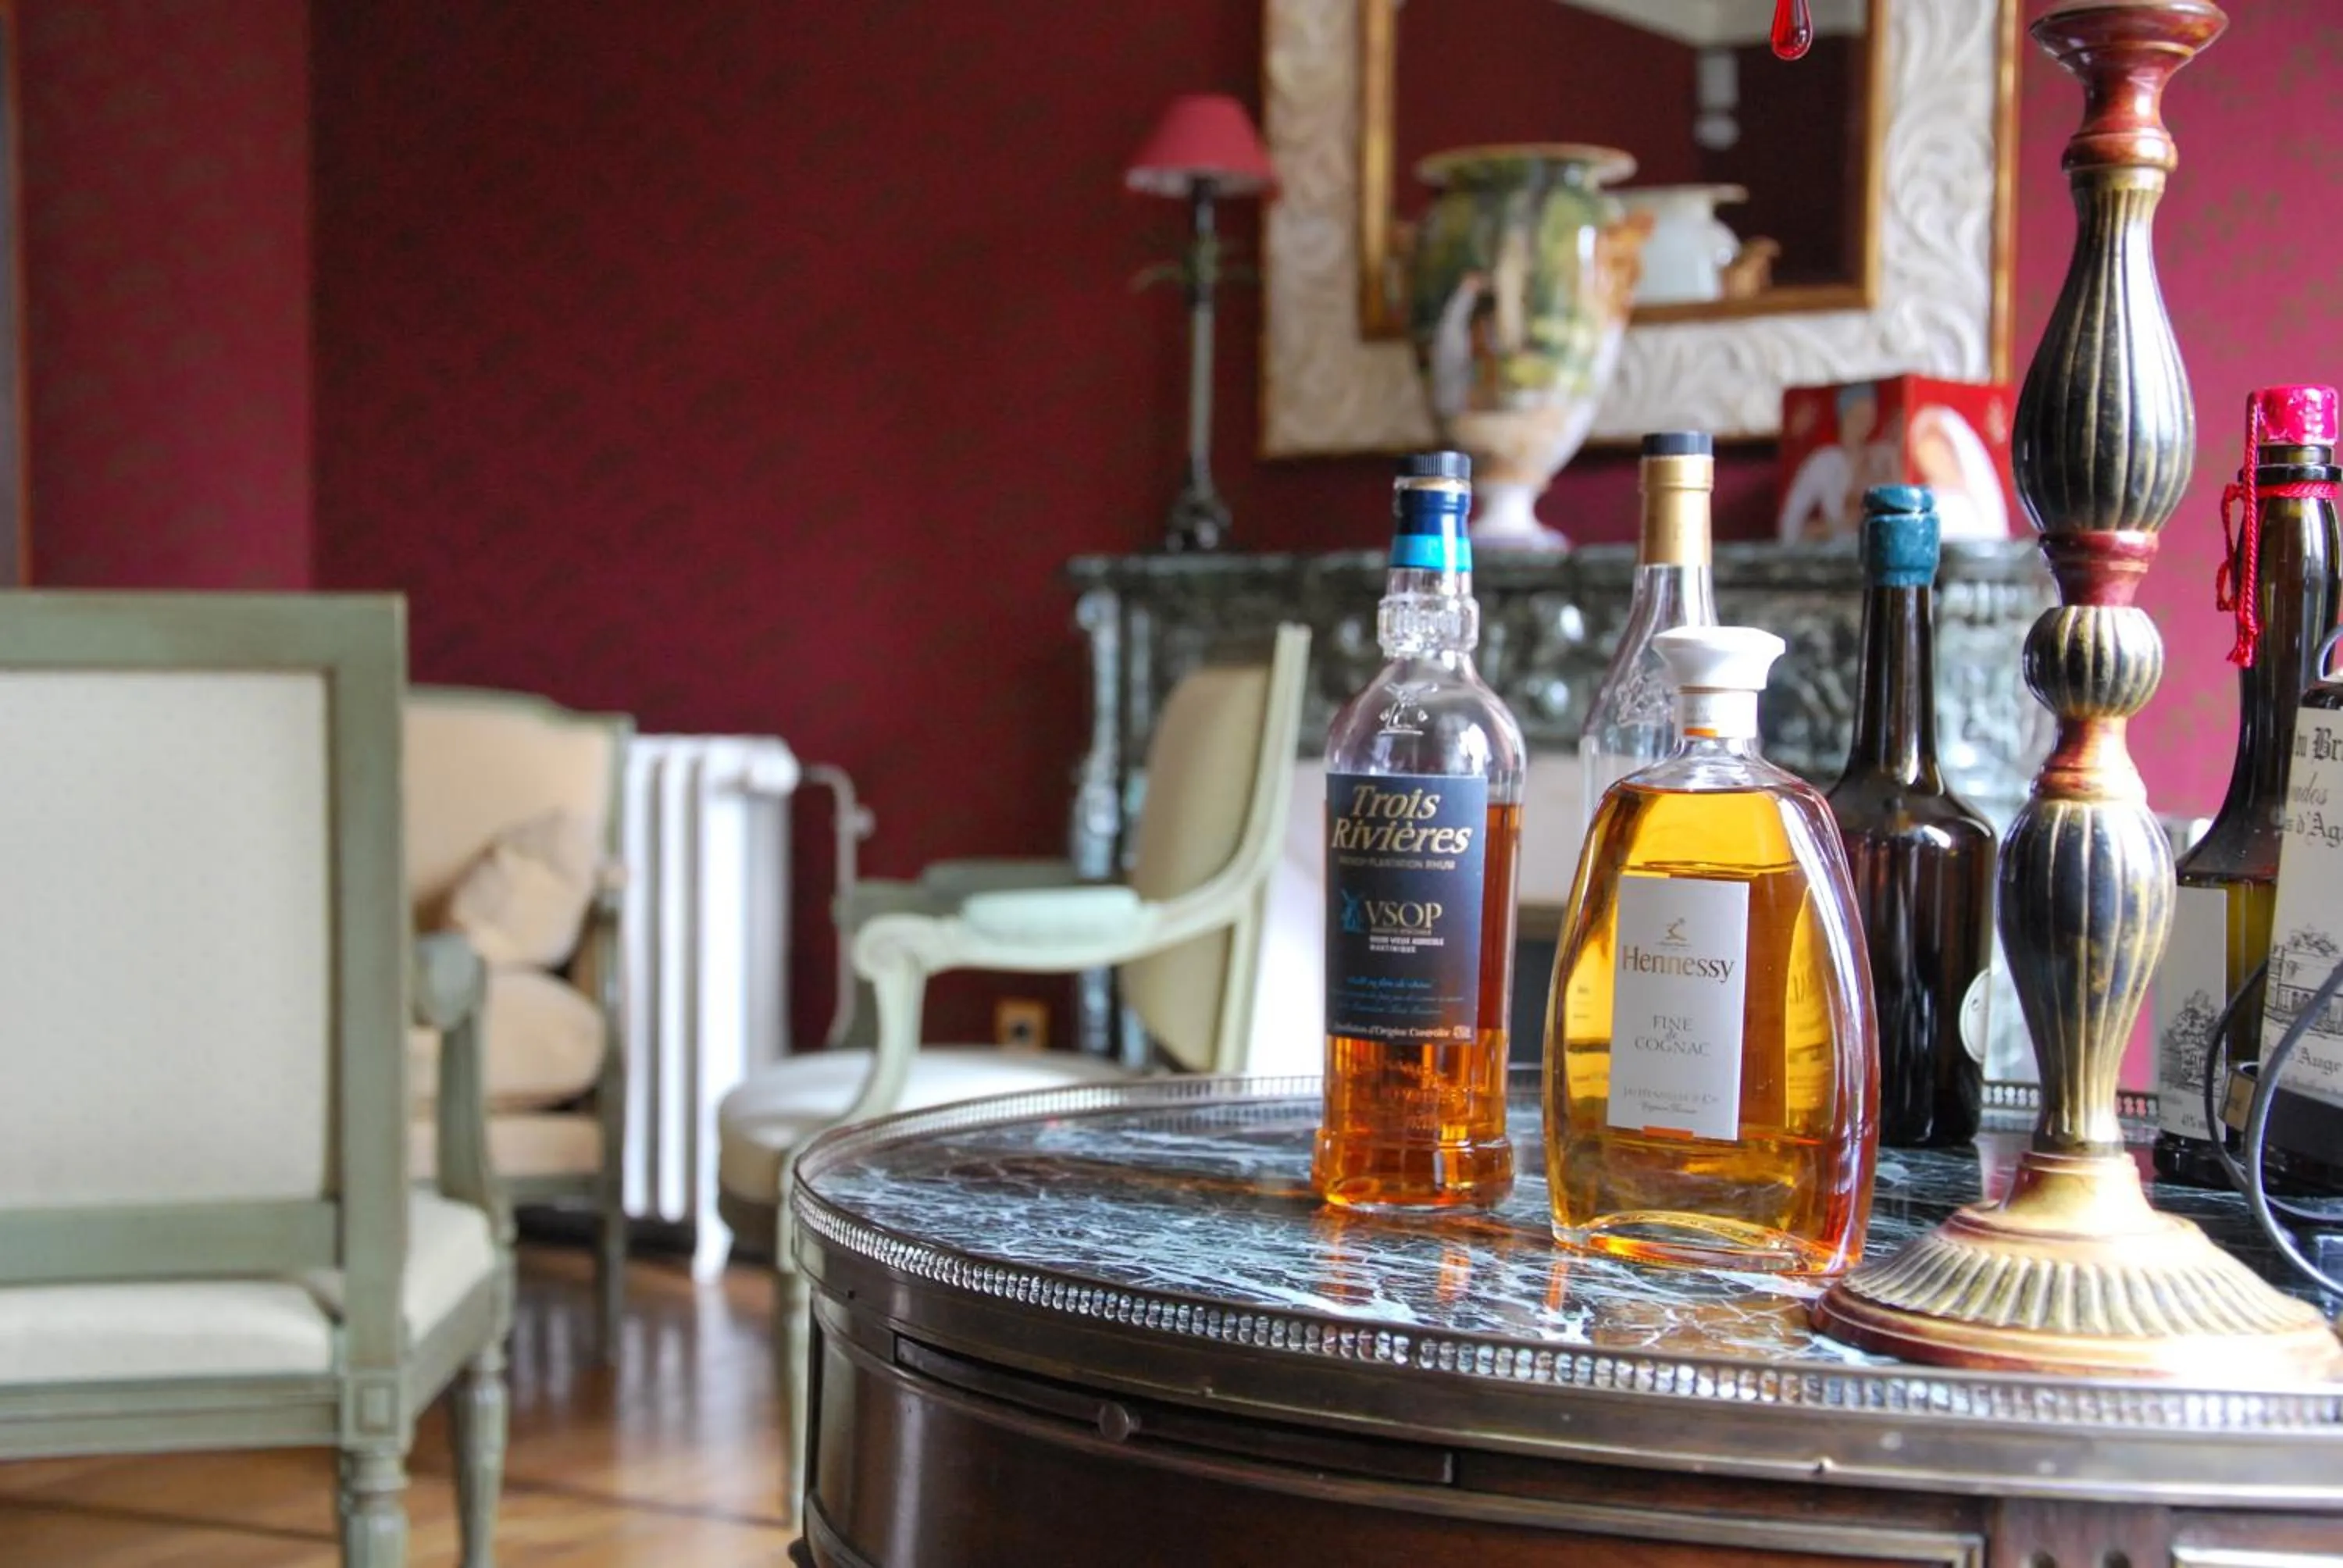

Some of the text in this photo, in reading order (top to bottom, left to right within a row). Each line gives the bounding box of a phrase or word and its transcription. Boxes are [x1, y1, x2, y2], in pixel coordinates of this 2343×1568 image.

[2313, 726, 2343, 761] Br
[1351, 784, 1441, 819] Trois
[1331, 817, 1474, 854] Rivières
[2296, 811, 2343, 849] d'Ag
[1365, 899, 1443, 929] VSOP
[1622, 945, 1735, 983] Hennessy
[1653, 1014, 1694, 1032] FINE
[1634, 1035, 1711, 1057] COGNAC
